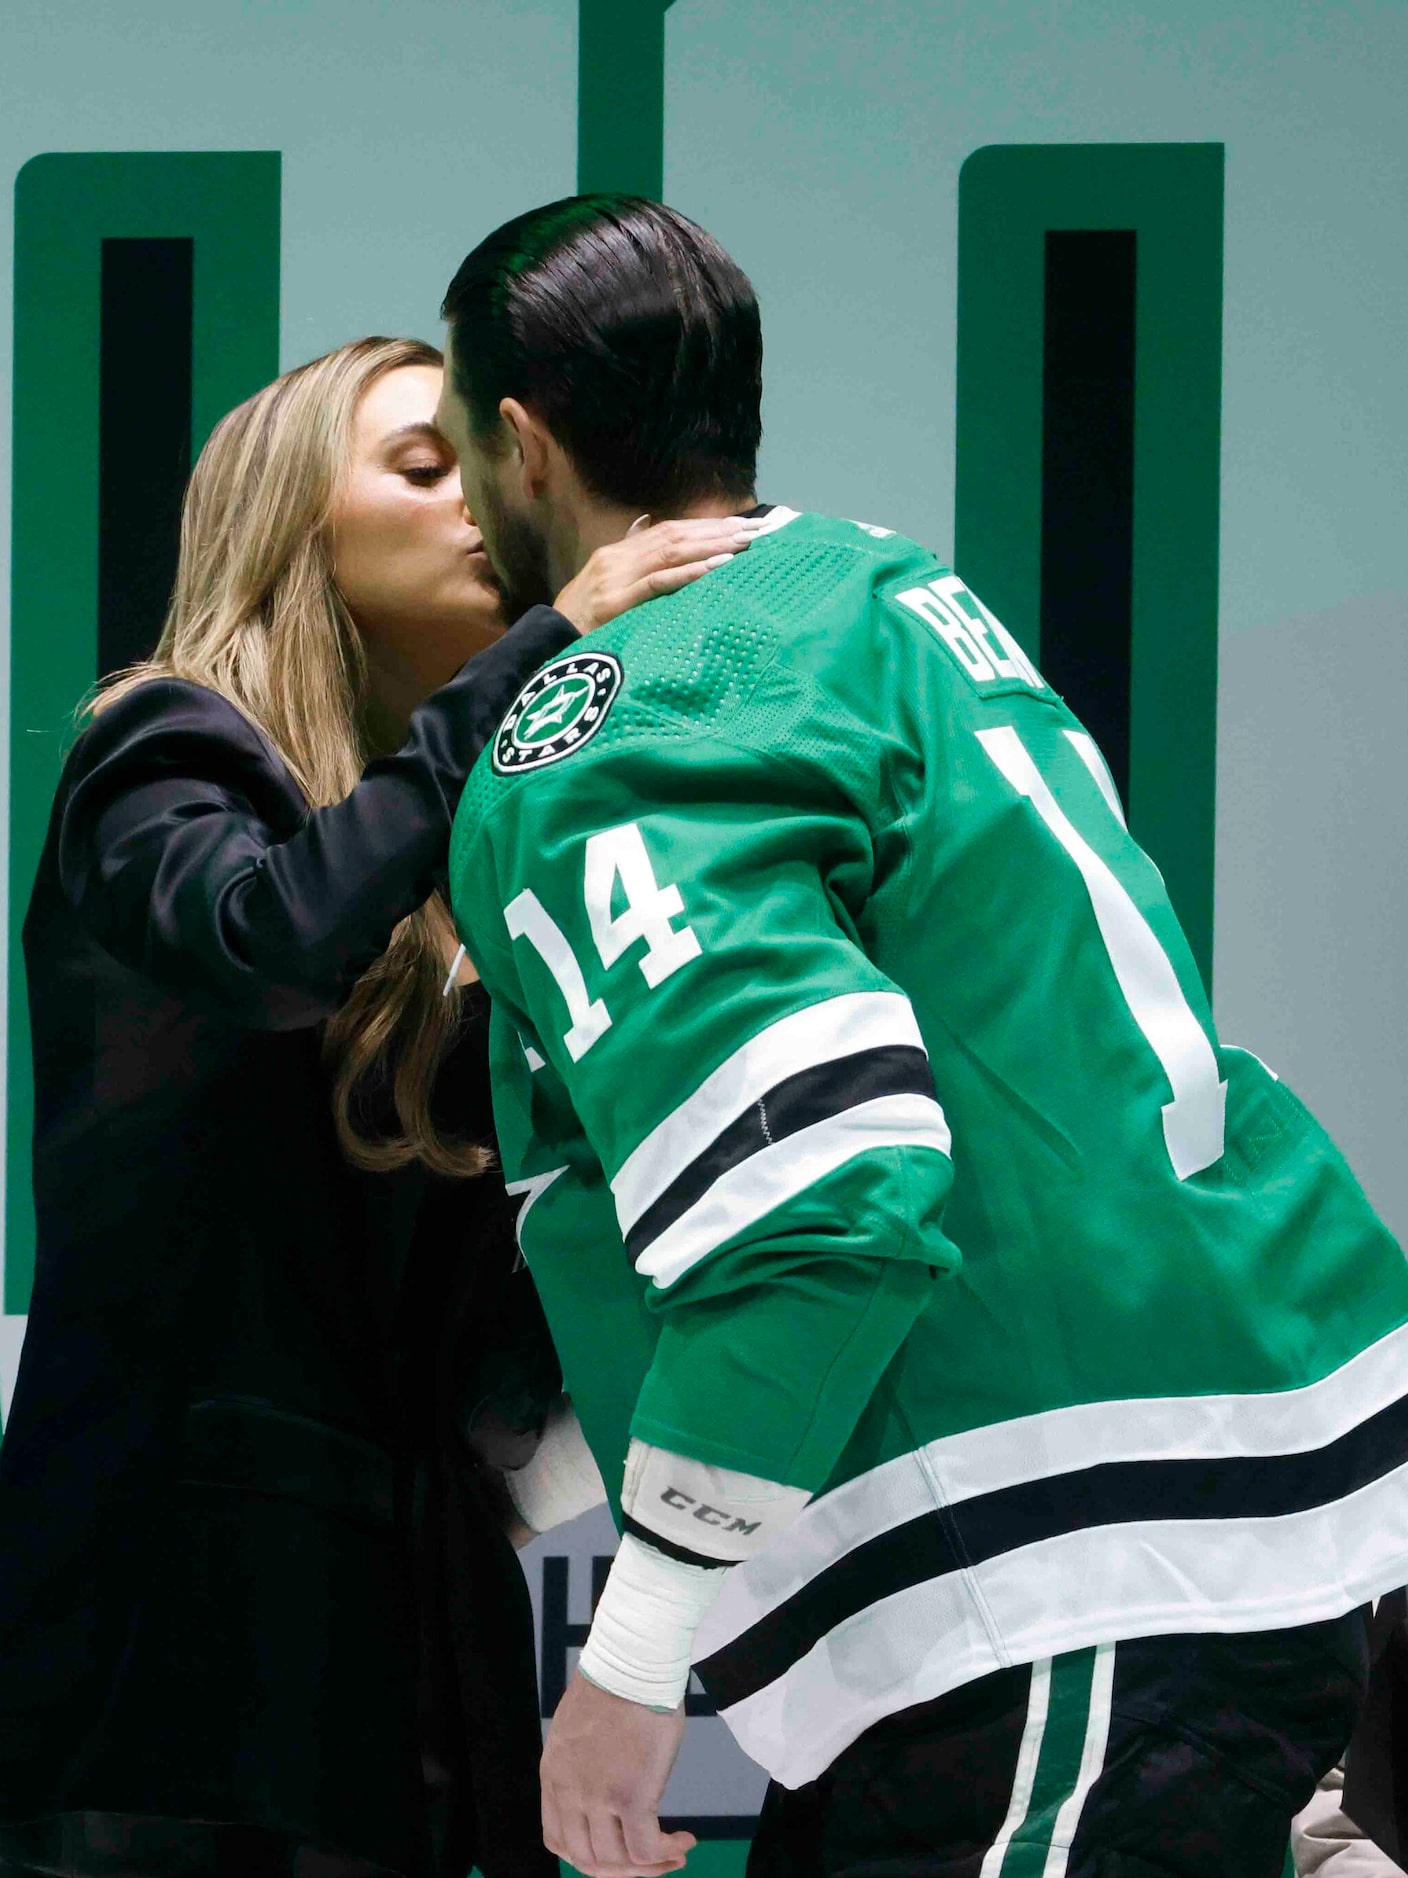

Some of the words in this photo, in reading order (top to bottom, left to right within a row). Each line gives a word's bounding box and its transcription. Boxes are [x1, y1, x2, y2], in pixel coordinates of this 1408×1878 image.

[503, 662, 611, 733] DALLAS
[501, 706, 600, 763] STARS
[503, 823, 702, 1063] 14
[660, 1486, 762, 1536] CCM
